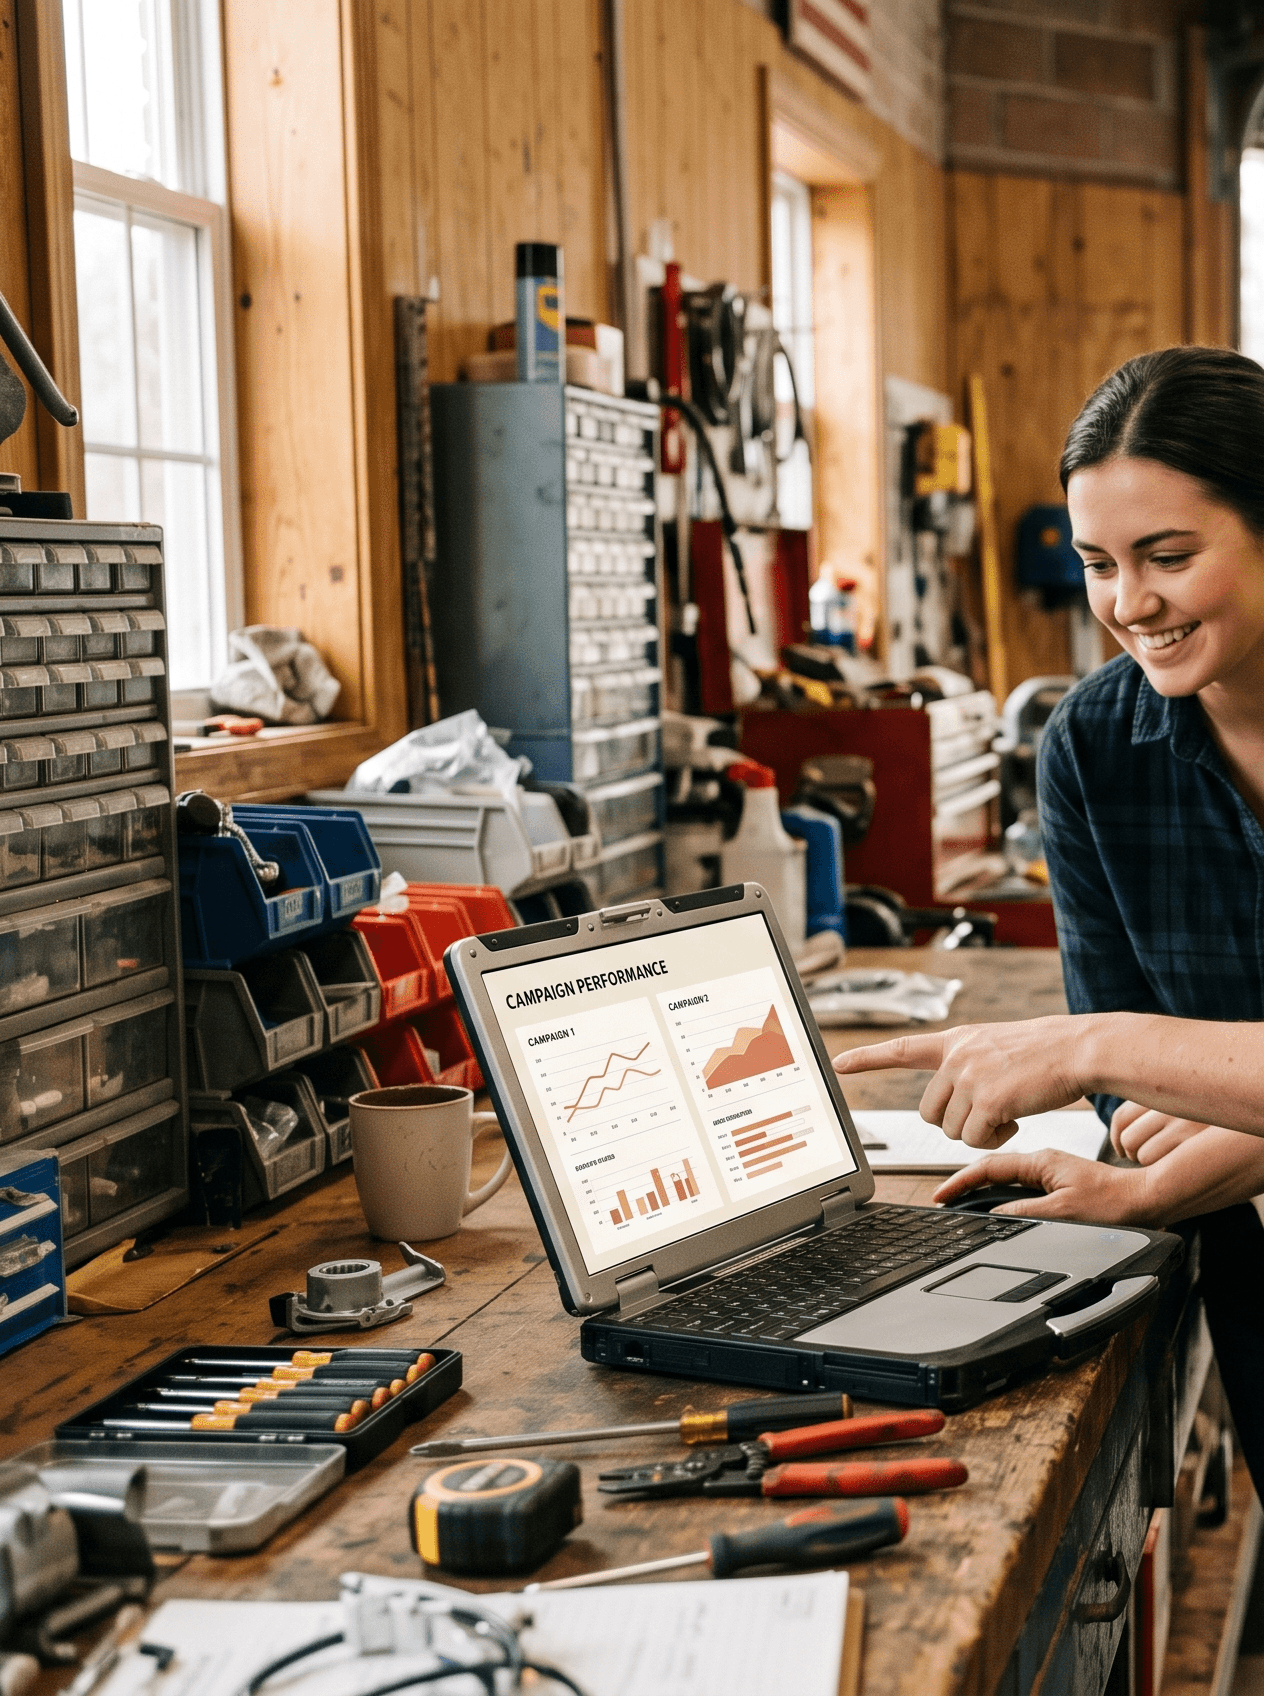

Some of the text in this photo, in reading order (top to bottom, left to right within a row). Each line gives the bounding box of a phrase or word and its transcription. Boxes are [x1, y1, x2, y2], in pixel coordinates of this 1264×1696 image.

[505, 959, 669, 1010] CAMPAIGN PERFORMANCE
[527, 1027, 576, 1047] CAMPAIGN 1
